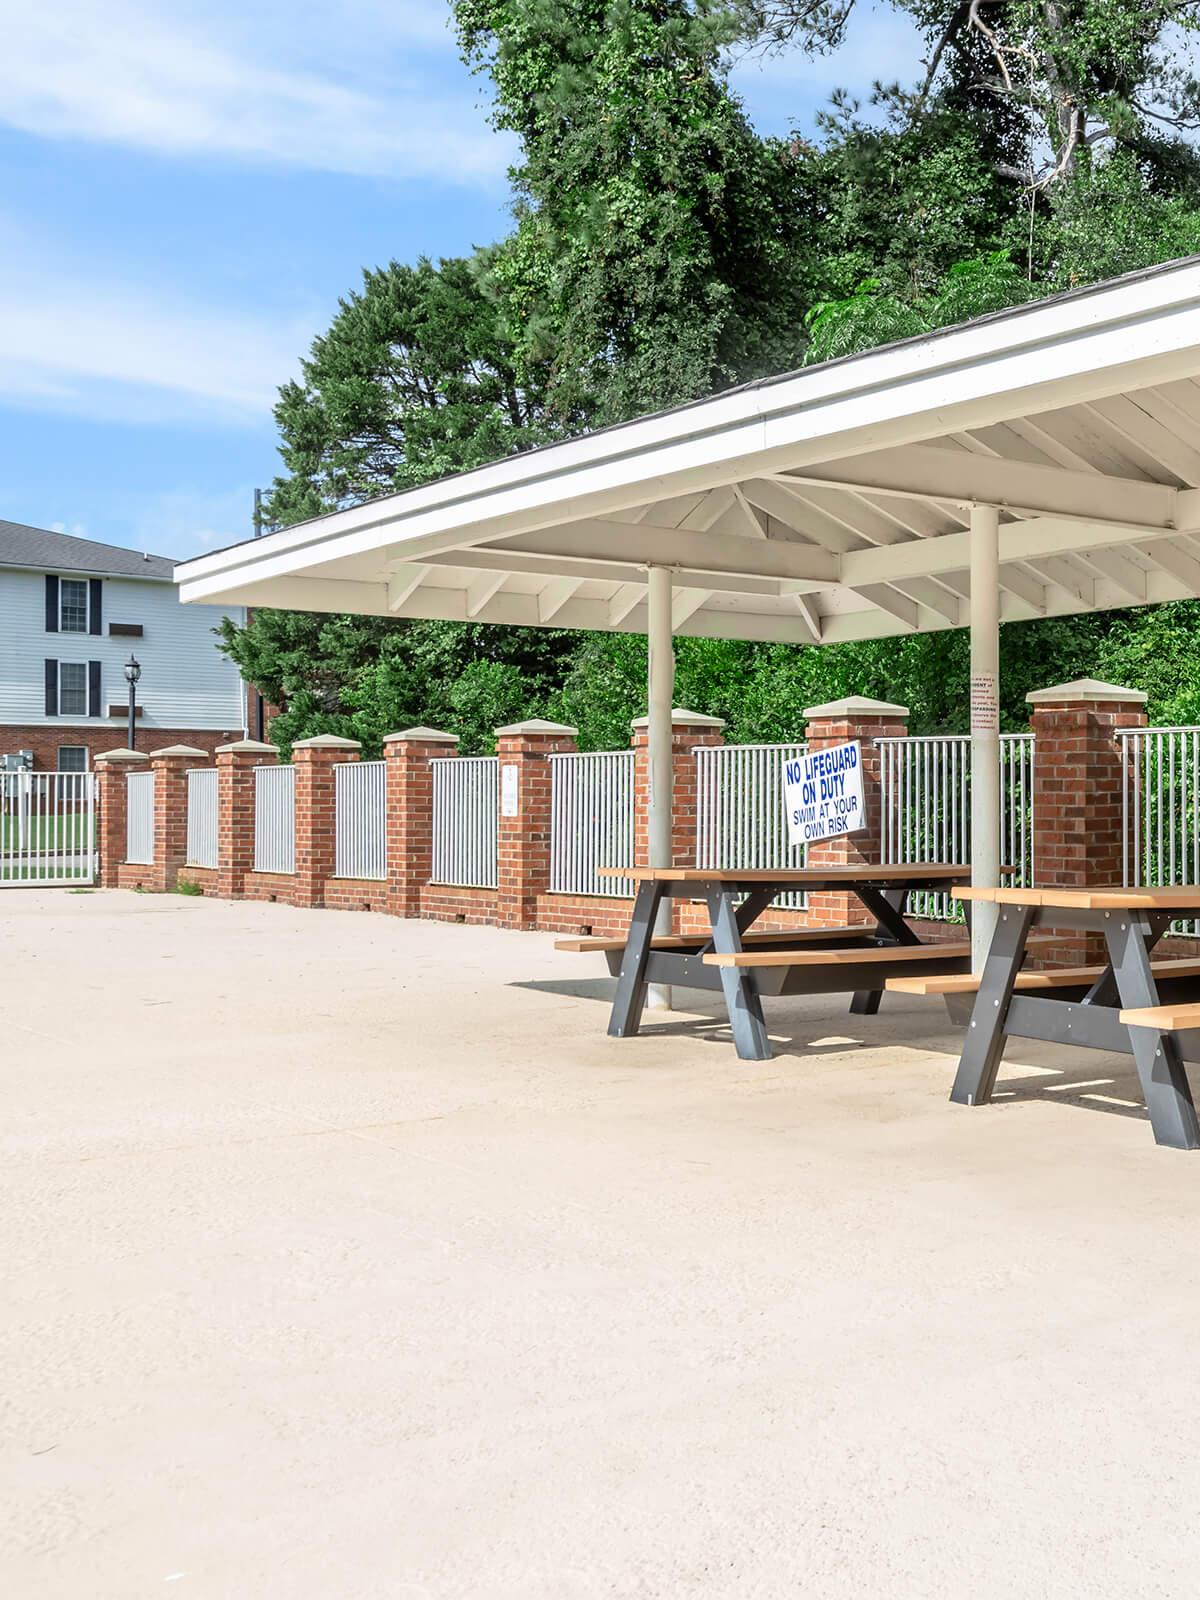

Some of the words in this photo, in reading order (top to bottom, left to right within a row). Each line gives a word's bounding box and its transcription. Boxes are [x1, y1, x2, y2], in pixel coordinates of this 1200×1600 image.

[786, 762, 801, 785] NO
[804, 745, 857, 780] LIFEGUARD
[802, 781, 816, 805] ON
[820, 773, 845, 800] DUTY
[793, 806, 815, 825] SWIM
[820, 802, 830, 819] AT
[833, 796, 857, 815] YOUR
[804, 821, 825, 839] OWN
[828, 815, 848, 834] RISK
